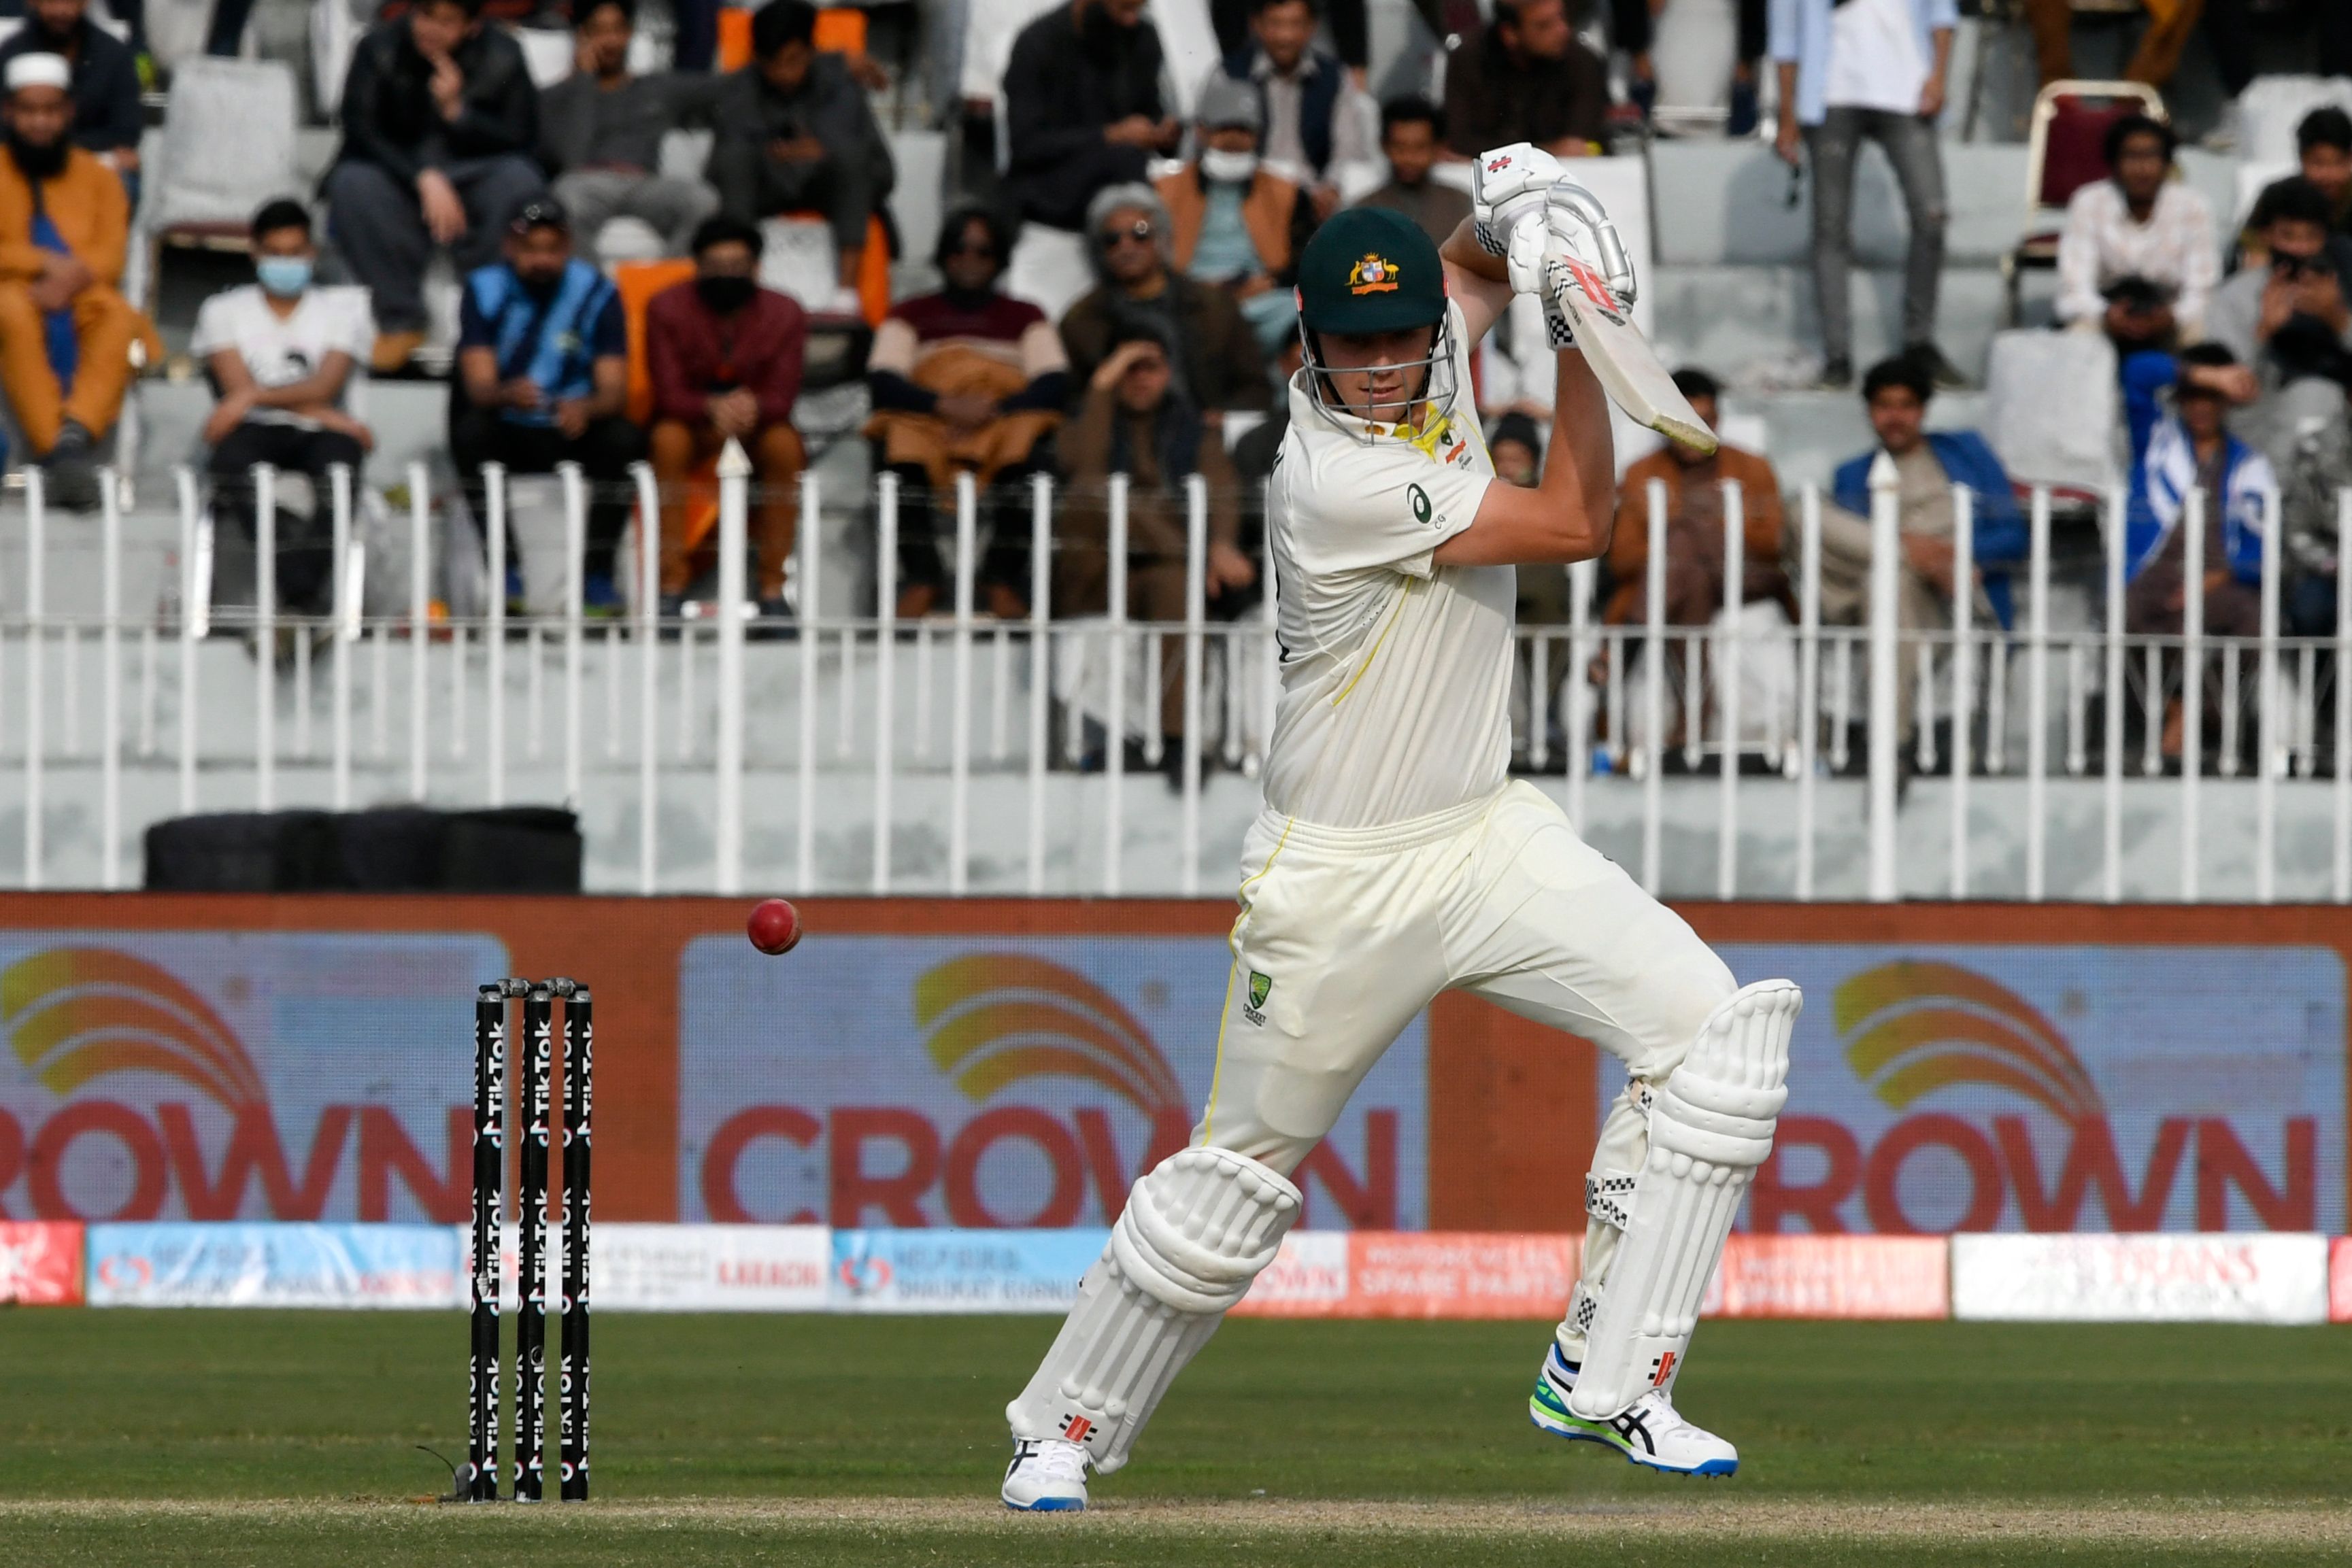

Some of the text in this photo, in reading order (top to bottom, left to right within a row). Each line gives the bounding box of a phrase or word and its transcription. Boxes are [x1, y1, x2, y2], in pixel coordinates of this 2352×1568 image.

[488, 1021, 503, 1117] TikTok
[534, 1020, 550, 1115] TikTok
[0, 1100, 475, 1221] OWN
[1750, 1112, 2317, 1234] ROWN
[535, 1188, 547, 1283] TikTok
